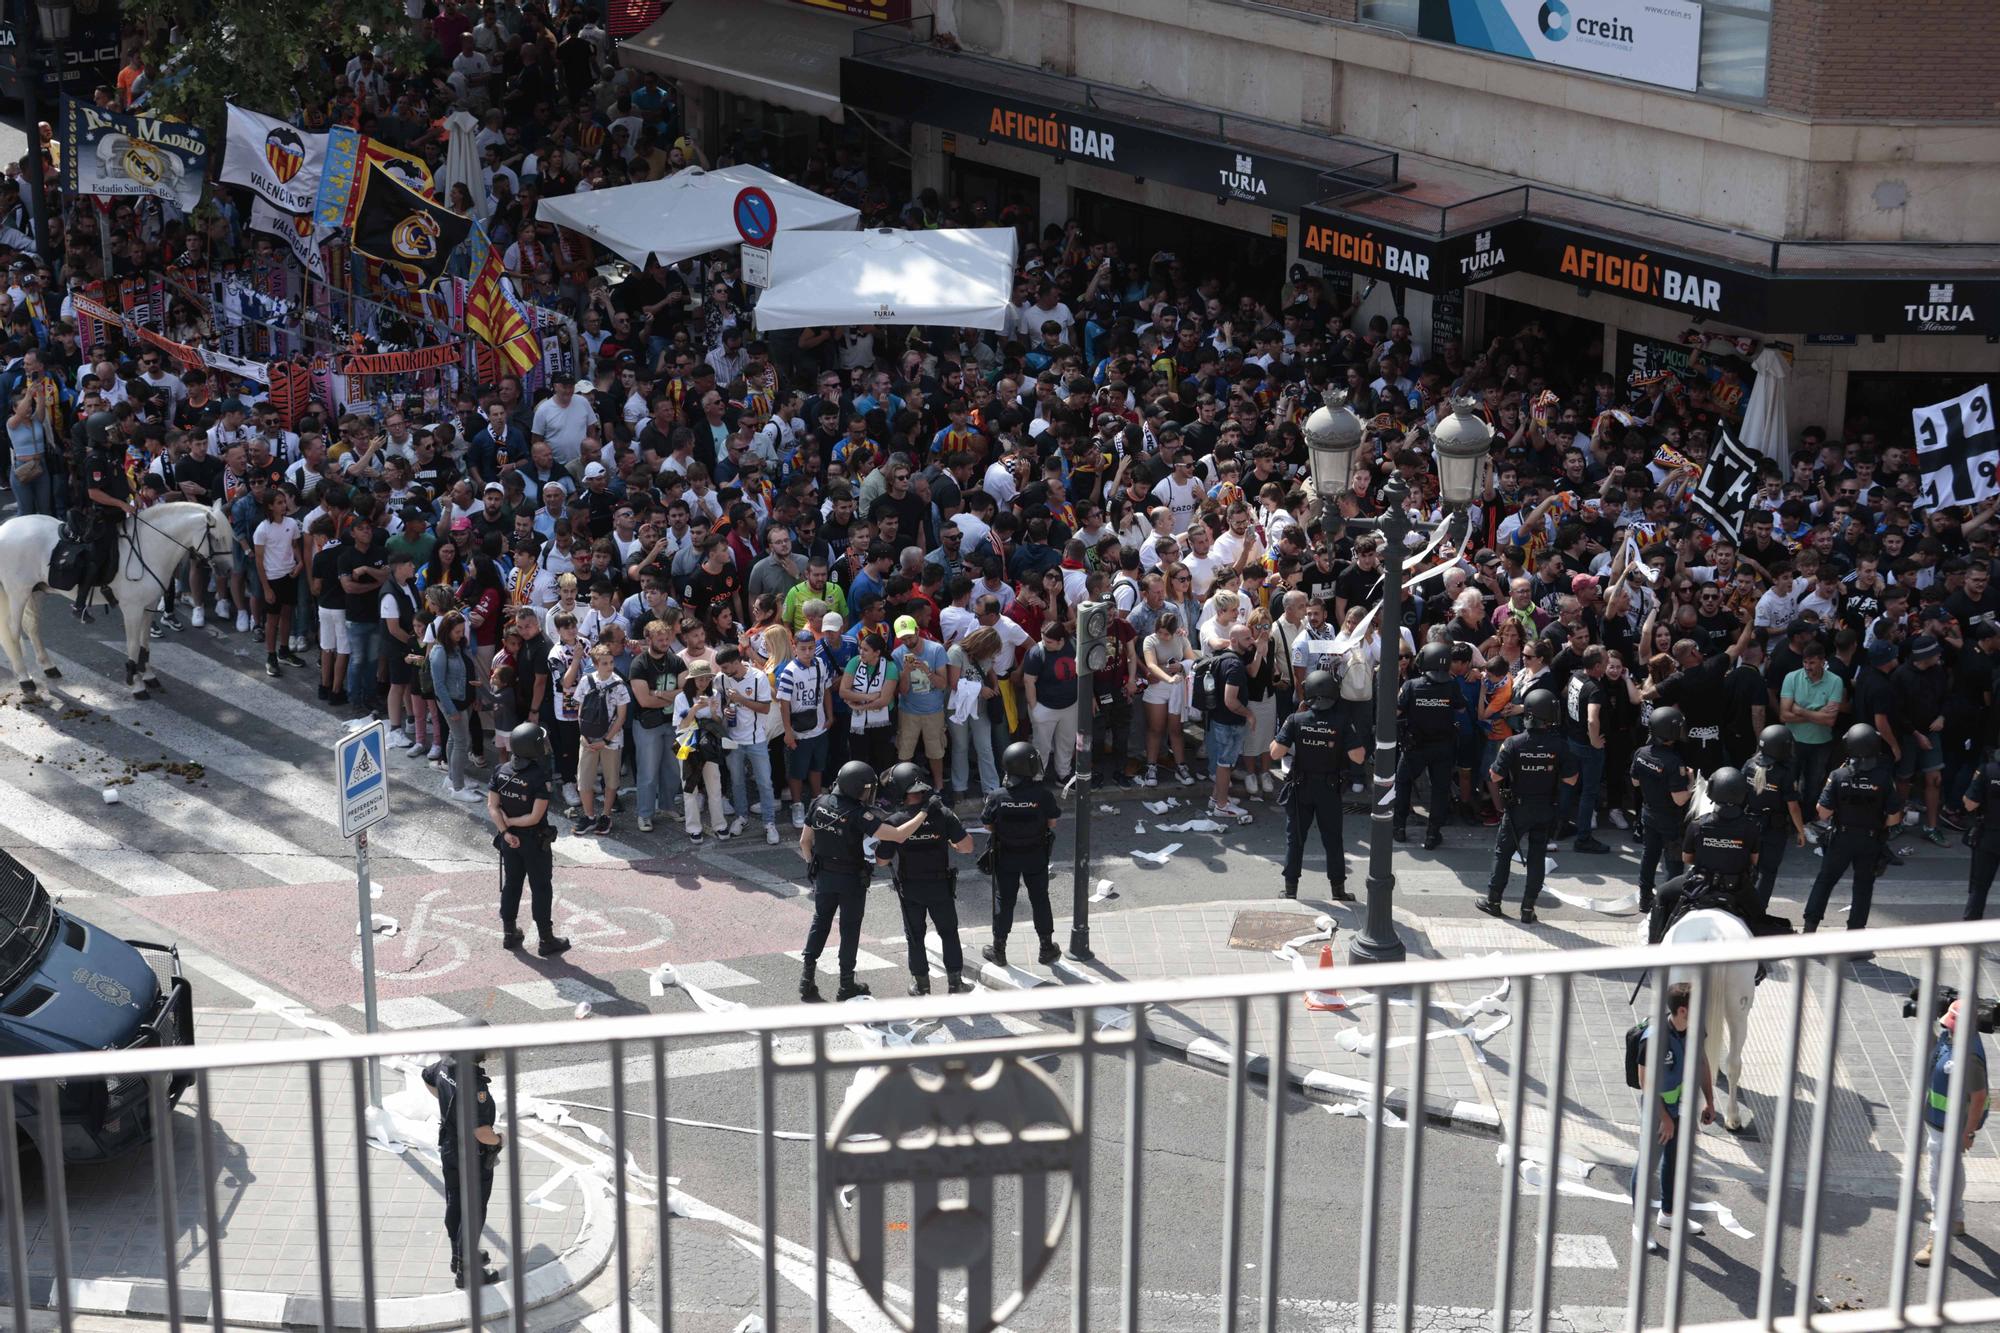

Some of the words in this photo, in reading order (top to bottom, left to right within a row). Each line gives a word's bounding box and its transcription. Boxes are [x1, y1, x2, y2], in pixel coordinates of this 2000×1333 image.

[1644, 5, 1692, 20] www.crein.es
[1576, 17, 1634, 43] crein
[1070, 125, 1115, 161] BAR
[250, 172, 295, 208] VALENCIA
[297, 196, 313, 209] CF
[1219, 170, 1267, 195] TURIA
[1385, 245, 1430, 281] BAR
[1460, 248, 1505, 274] TURIA
[1663, 269, 1721, 312] BAR
[1904, 305, 1975, 322] TURIA
[1300, 725, 1332, 735] POLICIA
[1636, 757, 1661, 773] POLICIA
[1841, 782, 1875, 791] PLICIA
[347, 794, 383, 818] PREFERENCIA
[353, 805, 379, 823] CICLISTA
[1000, 801, 1034, 809] POLICIA
[1703, 837, 1733, 845] POLICIA
